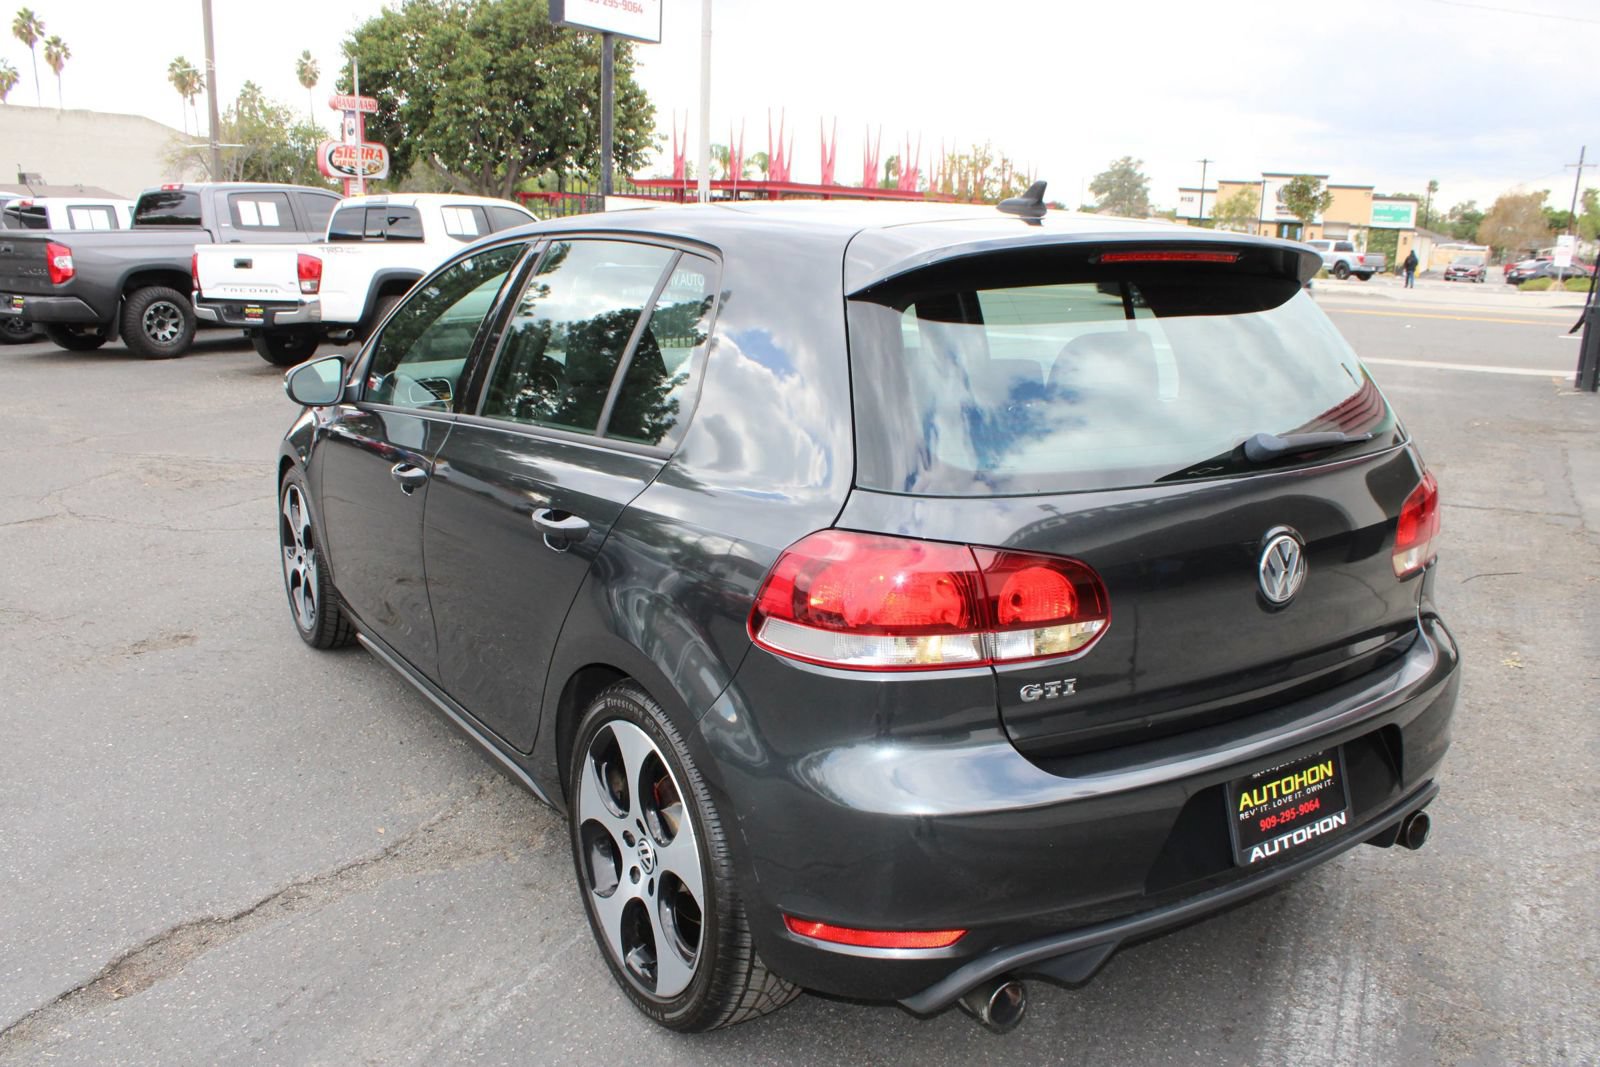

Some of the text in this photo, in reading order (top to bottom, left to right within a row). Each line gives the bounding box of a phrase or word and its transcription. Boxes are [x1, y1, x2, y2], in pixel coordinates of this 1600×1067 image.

[1020, 678, 1077, 703] GTI
[606, 697, 643, 720] Firestone
[1239, 760, 1334, 812] AUTOHON
[1273, 795, 1293, 808] LOVE
[1306, 784, 1323, 795] OWN
[1259, 798, 1320, 831] 909-295-9064
[1250, 811, 1347, 863] AUTOHON
